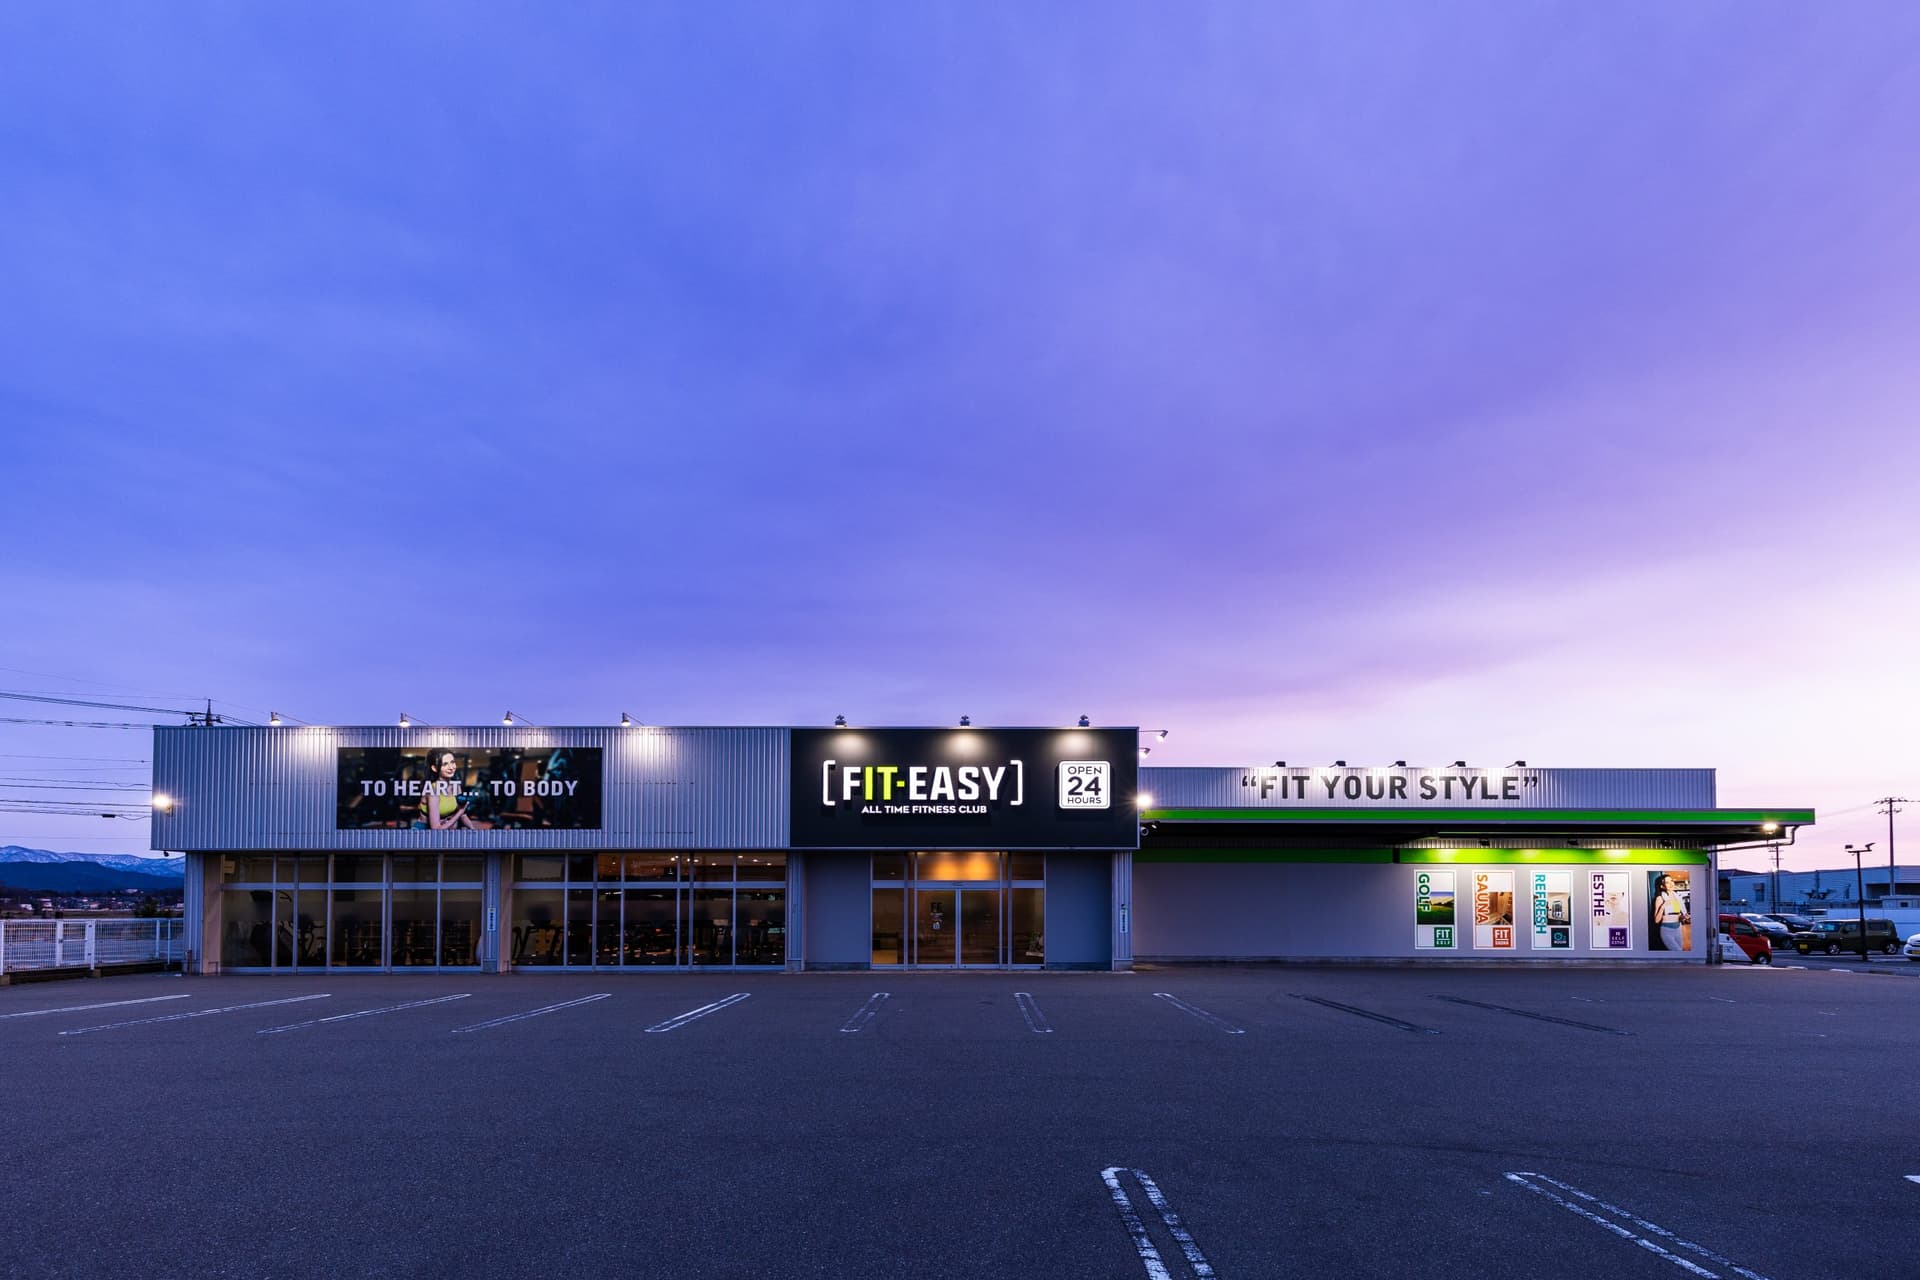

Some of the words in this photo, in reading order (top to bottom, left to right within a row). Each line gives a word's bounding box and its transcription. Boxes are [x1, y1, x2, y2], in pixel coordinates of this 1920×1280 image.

[1067, 766, 1102, 775] OPEN
[360, 780, 387, 797] TO
[393, 780, 479, 797] HEART...
[490, 780, 517, 797] TO
[523, 780, 578, 797] BODY
[1067, 776, 1102, 796] 24
[1320, 775, 1407, 800] YOUR
[1067, 796, 1102, 804] HOURS
[861, 805, 882, 814] ALL
[884, 805, 909, 814] TIME
[912, 805, 957, 814] FITNESS
[958, 805, 988, 814] CLUB
[1418, 873, 1431, 912] GOLF
[1477, 874, 1489, 924] SAUNA
[1535, 874, 1547, 934] REFRESH
[1436, 929, 1450, 938] FIT
[1495, 929, 1509, 938] FIT
